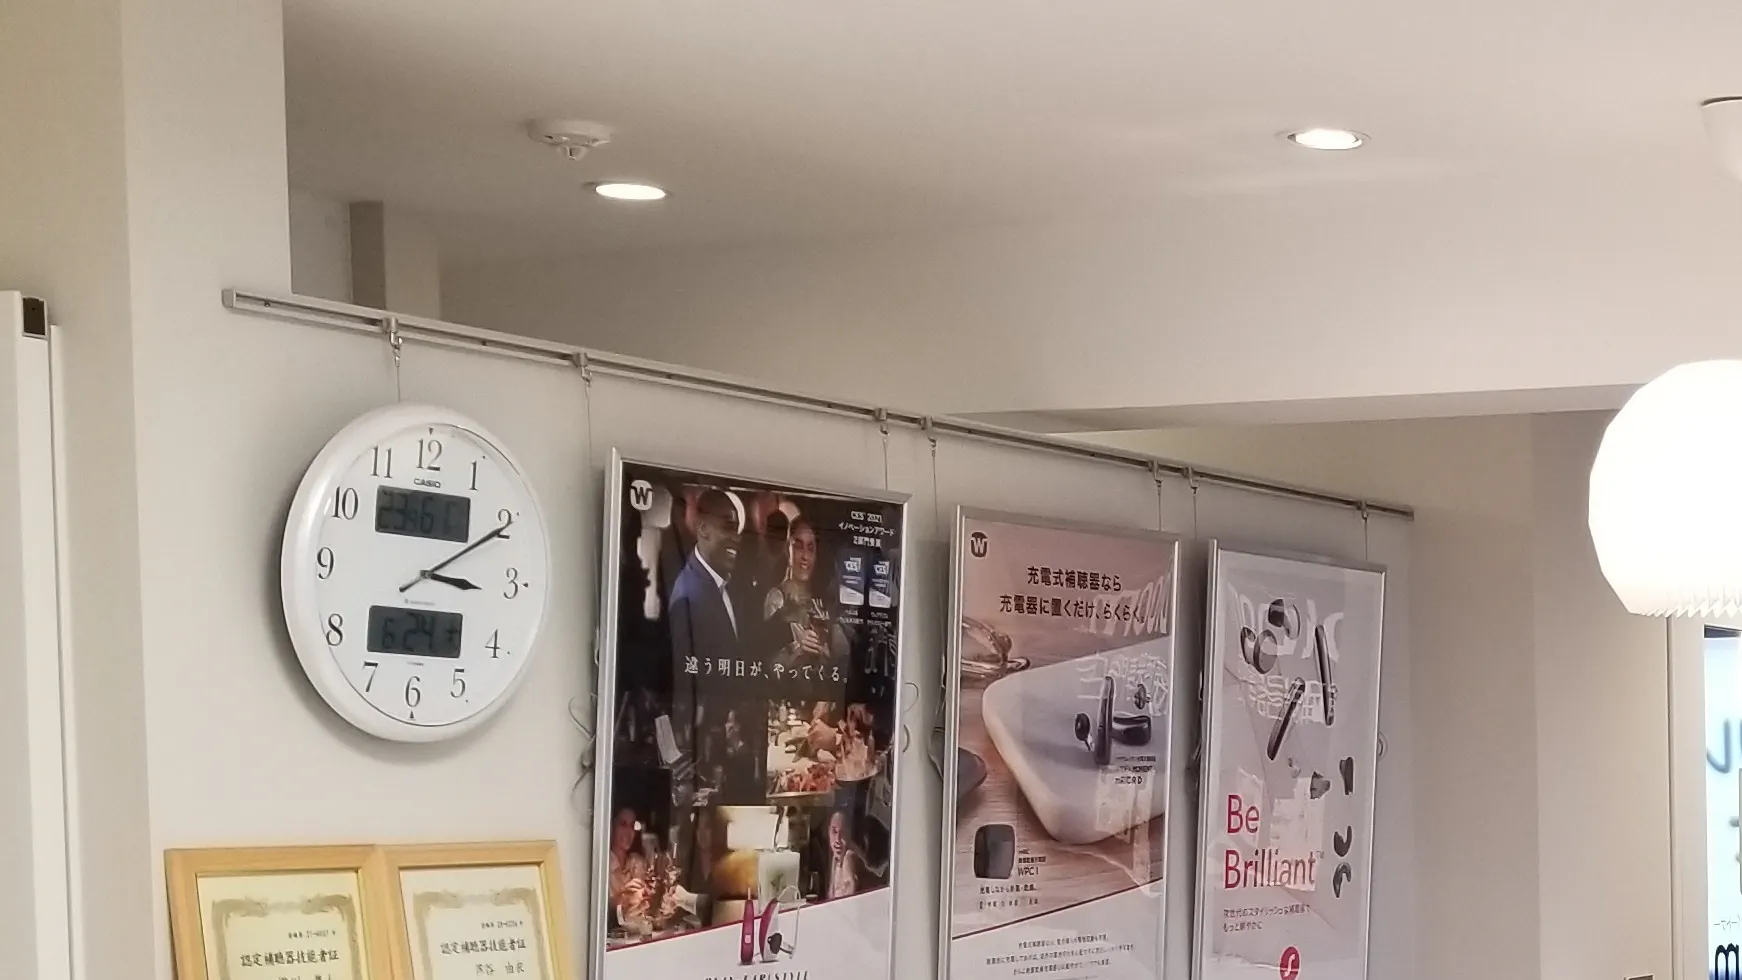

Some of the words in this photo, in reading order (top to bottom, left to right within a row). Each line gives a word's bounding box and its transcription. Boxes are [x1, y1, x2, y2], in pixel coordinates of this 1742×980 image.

[370, 445, 393, 479] 11
[417, 438, 442, 472] 12
[413, 477, 441, 489] CASIO
[469, 460, 478, 491] 1
[331, 486, 359, 520] 10
[497, 508, 511, 539] 2
[317, 547, 335, 579] 9
[1027, 566, 1122, 592] 充電式補聴器なら
[503, 567, 519, 600] 3
[325, 613, 344, 647] 8
[485, 629, 500, 659] 4
[362, 661, 379, 692] 7
[405, 675, 421, 708] 6
[450, 668, 466, 698] 5
[1227, 794, 1260, 834] Be
[1224, 849, 1316, 889] Brilliant
